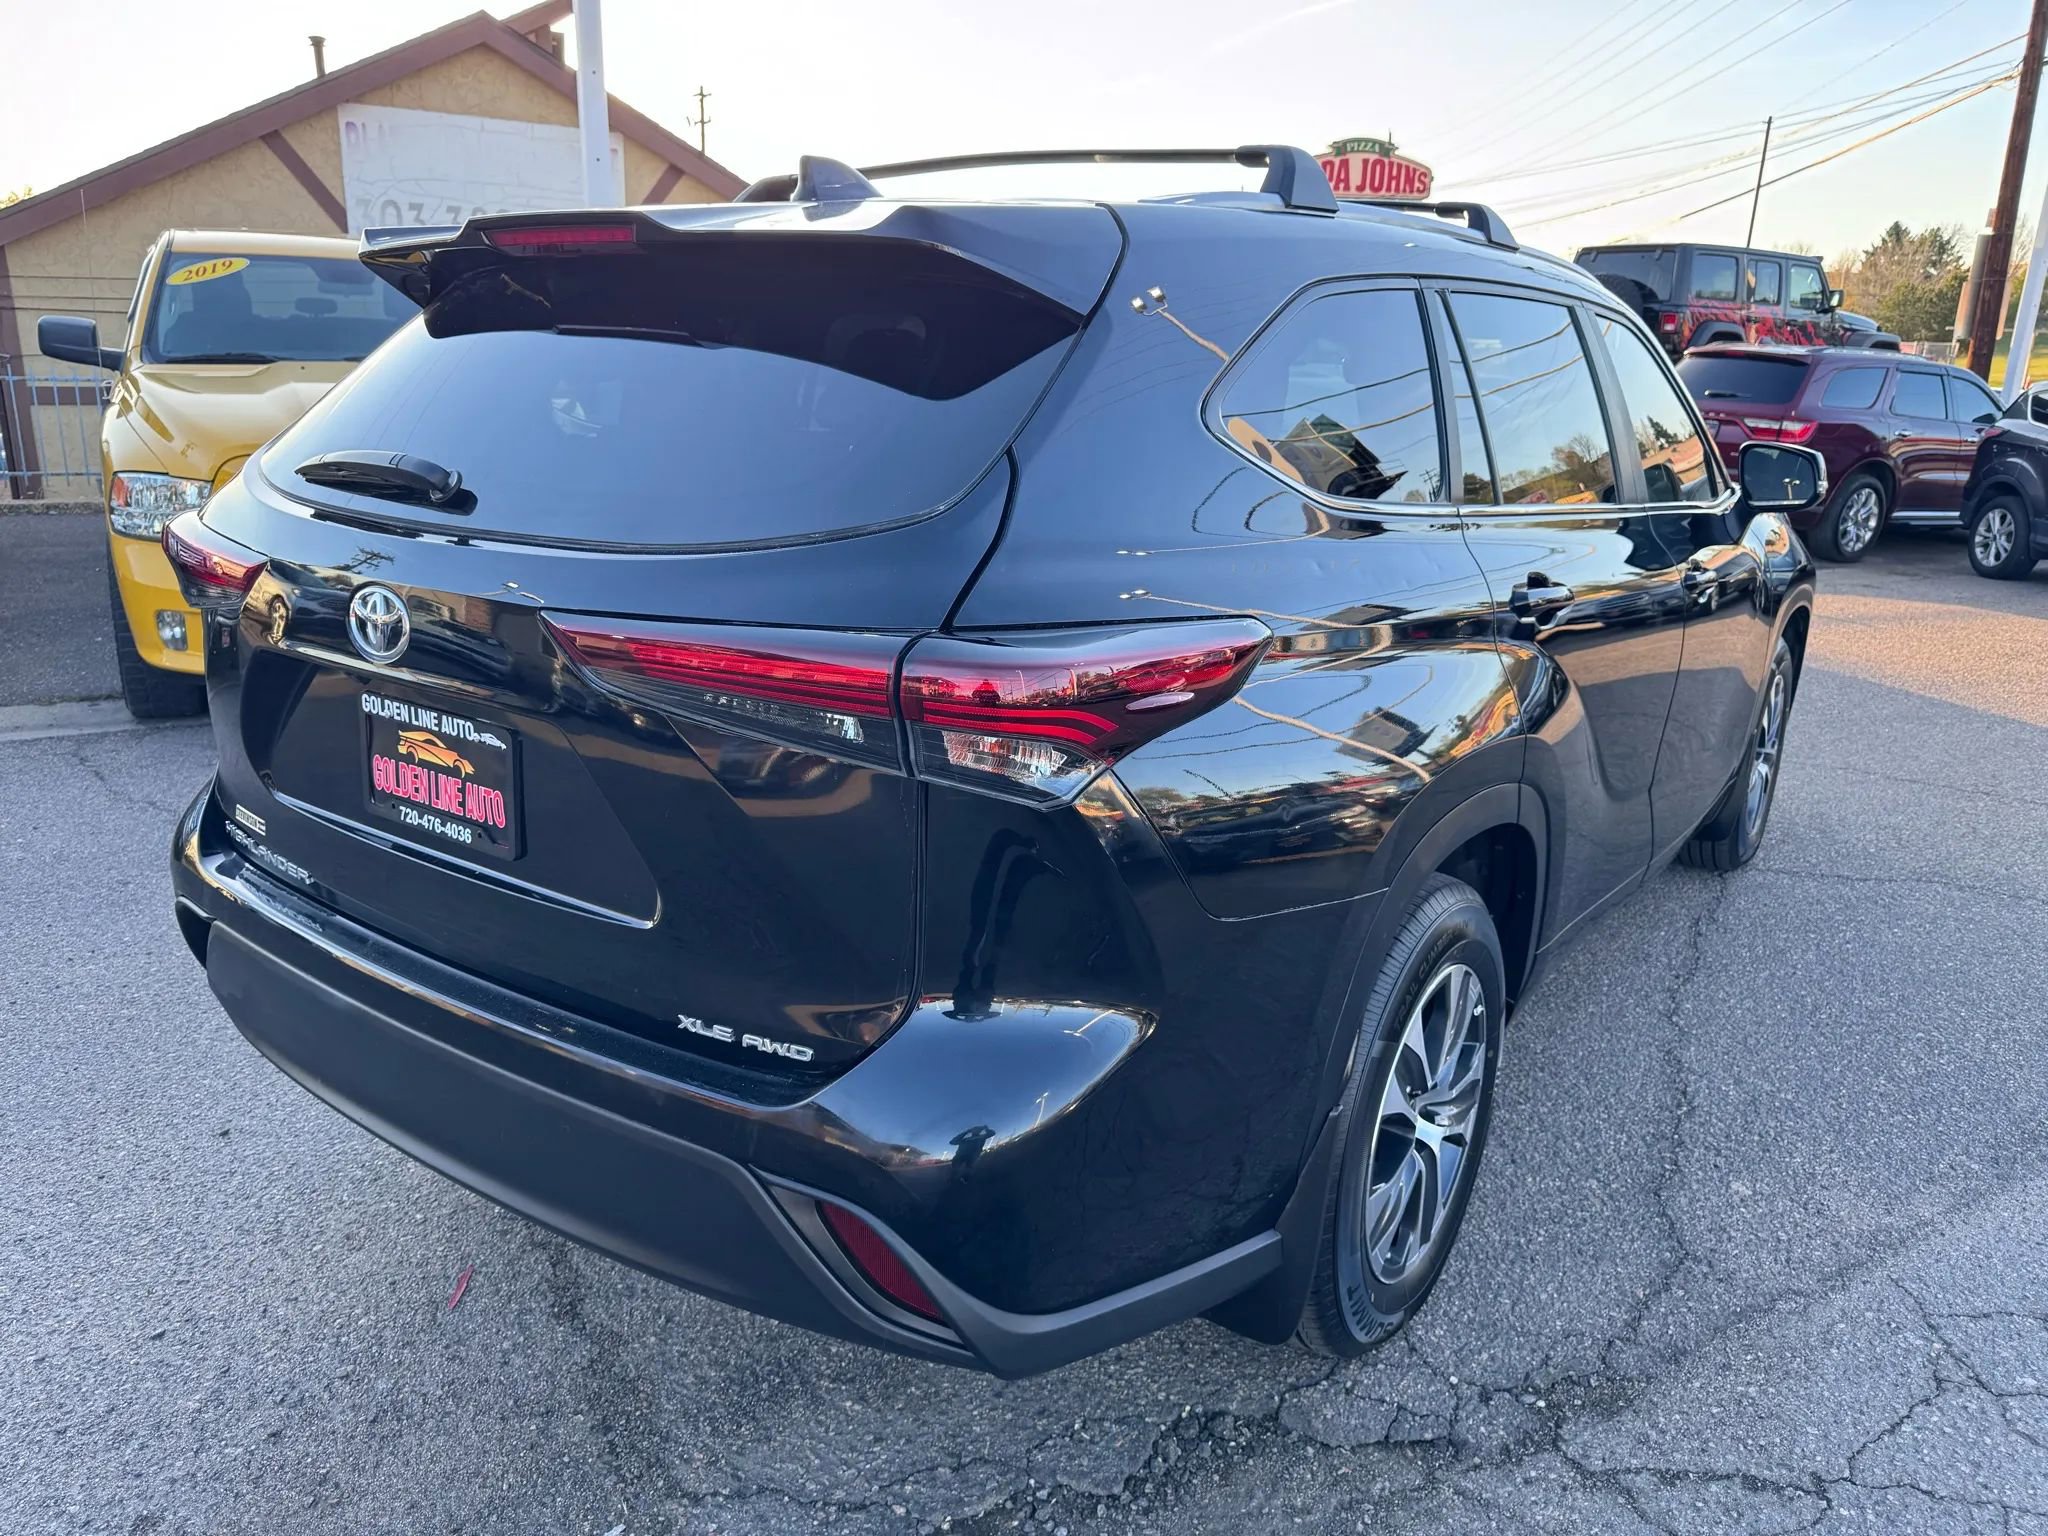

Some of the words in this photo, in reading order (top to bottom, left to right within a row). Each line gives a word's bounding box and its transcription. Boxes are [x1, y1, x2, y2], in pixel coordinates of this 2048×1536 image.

[1346, 141, 1381, 153] PIZZA
[1321, 158, 1351, 191] PA
[1355, 158, 1428, 194] JOHNS
[182, 259, 233, 282] 2019
[361, 693, 409, 723] GOLDEN
[410, 706, 439, 731] LINE
[441, 714, 475, 741] AUTO
[372, 754, 429, 805] GOLDEN
[430, 770, 464, 816] LINE
[465, 782, 506, 828] AUTO
[399, 806, 472, 844] 720-476-4036
[677, 1014, 735, 1043] XLE
[741, 1033, 814, 1062] AWD
